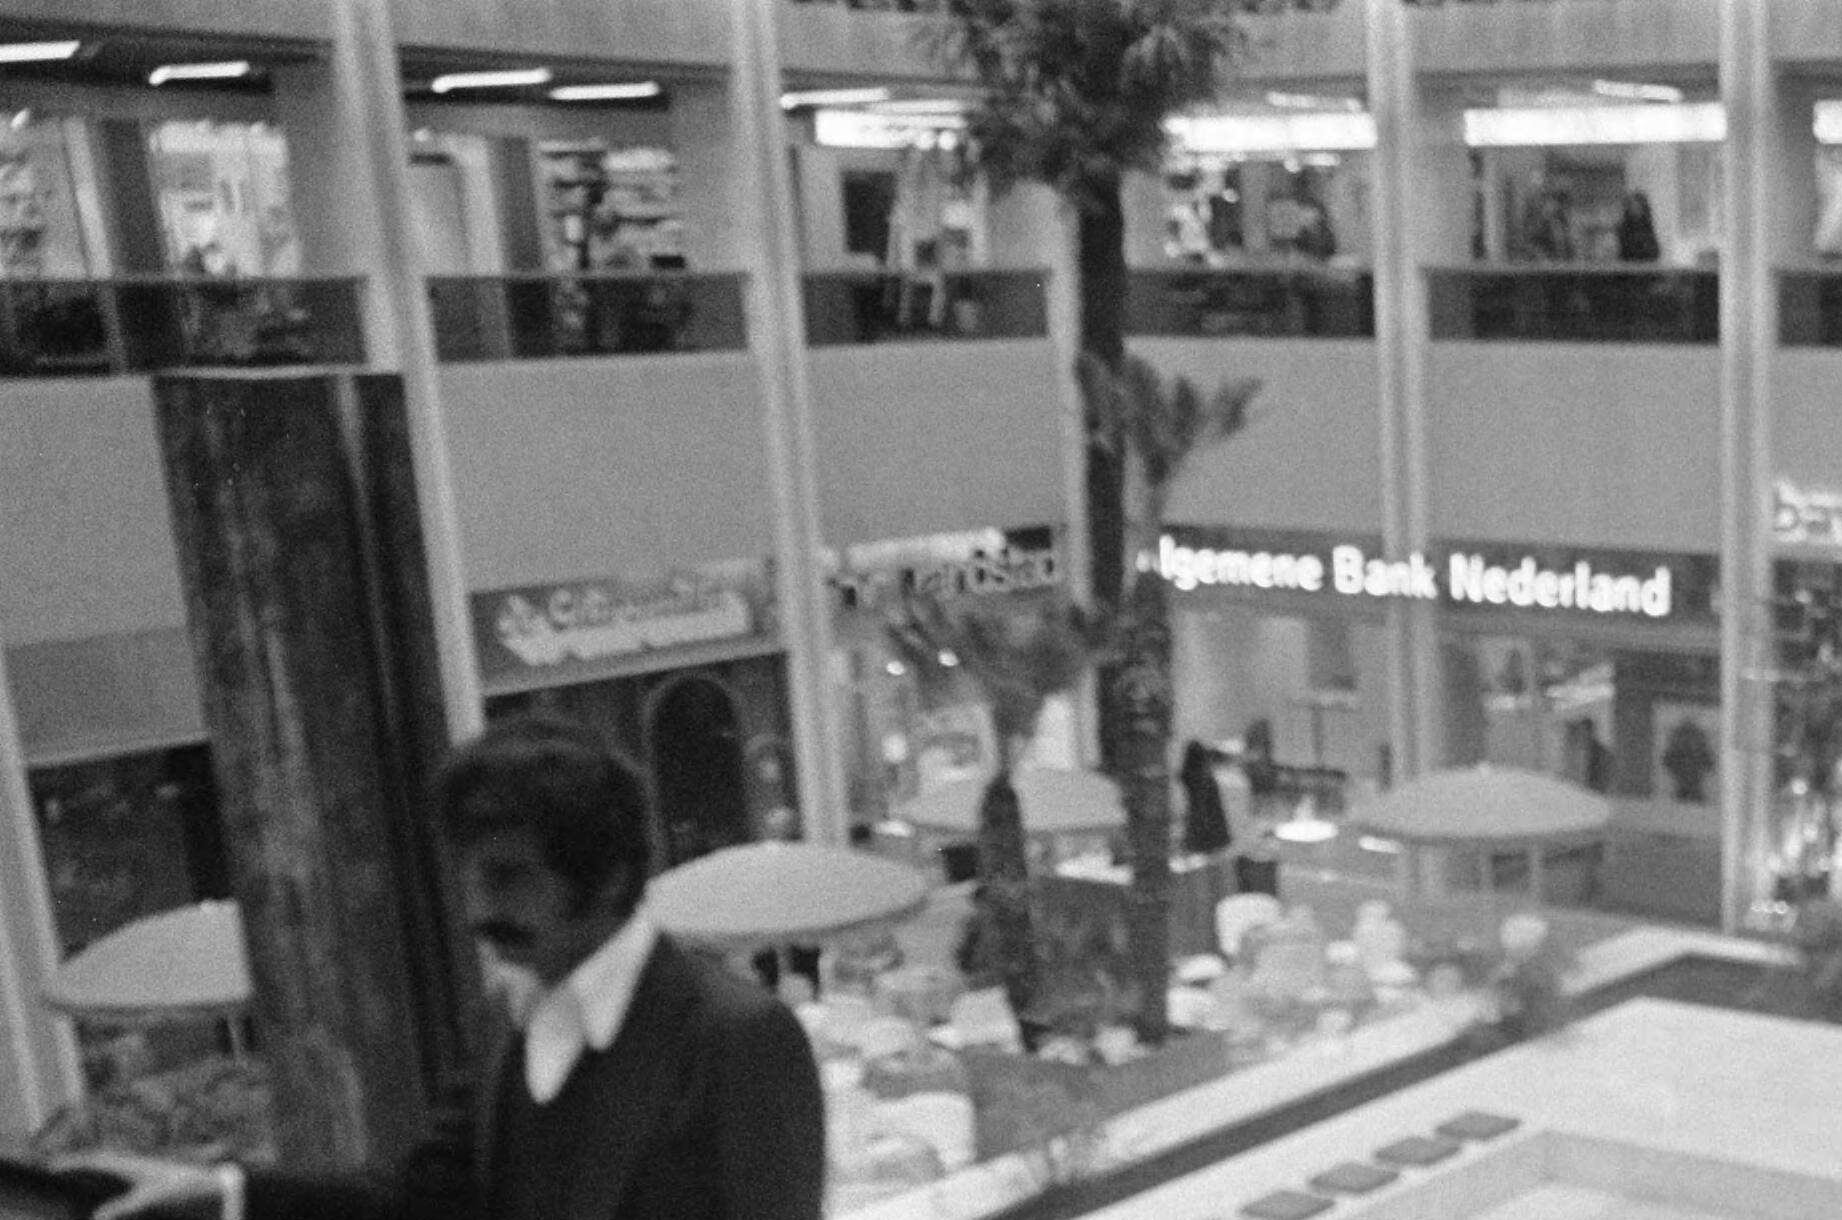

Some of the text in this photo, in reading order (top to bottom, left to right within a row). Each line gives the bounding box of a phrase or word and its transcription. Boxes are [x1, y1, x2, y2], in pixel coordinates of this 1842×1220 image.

[1137, 534, 1672, 617] lgemene Bank Nederland
